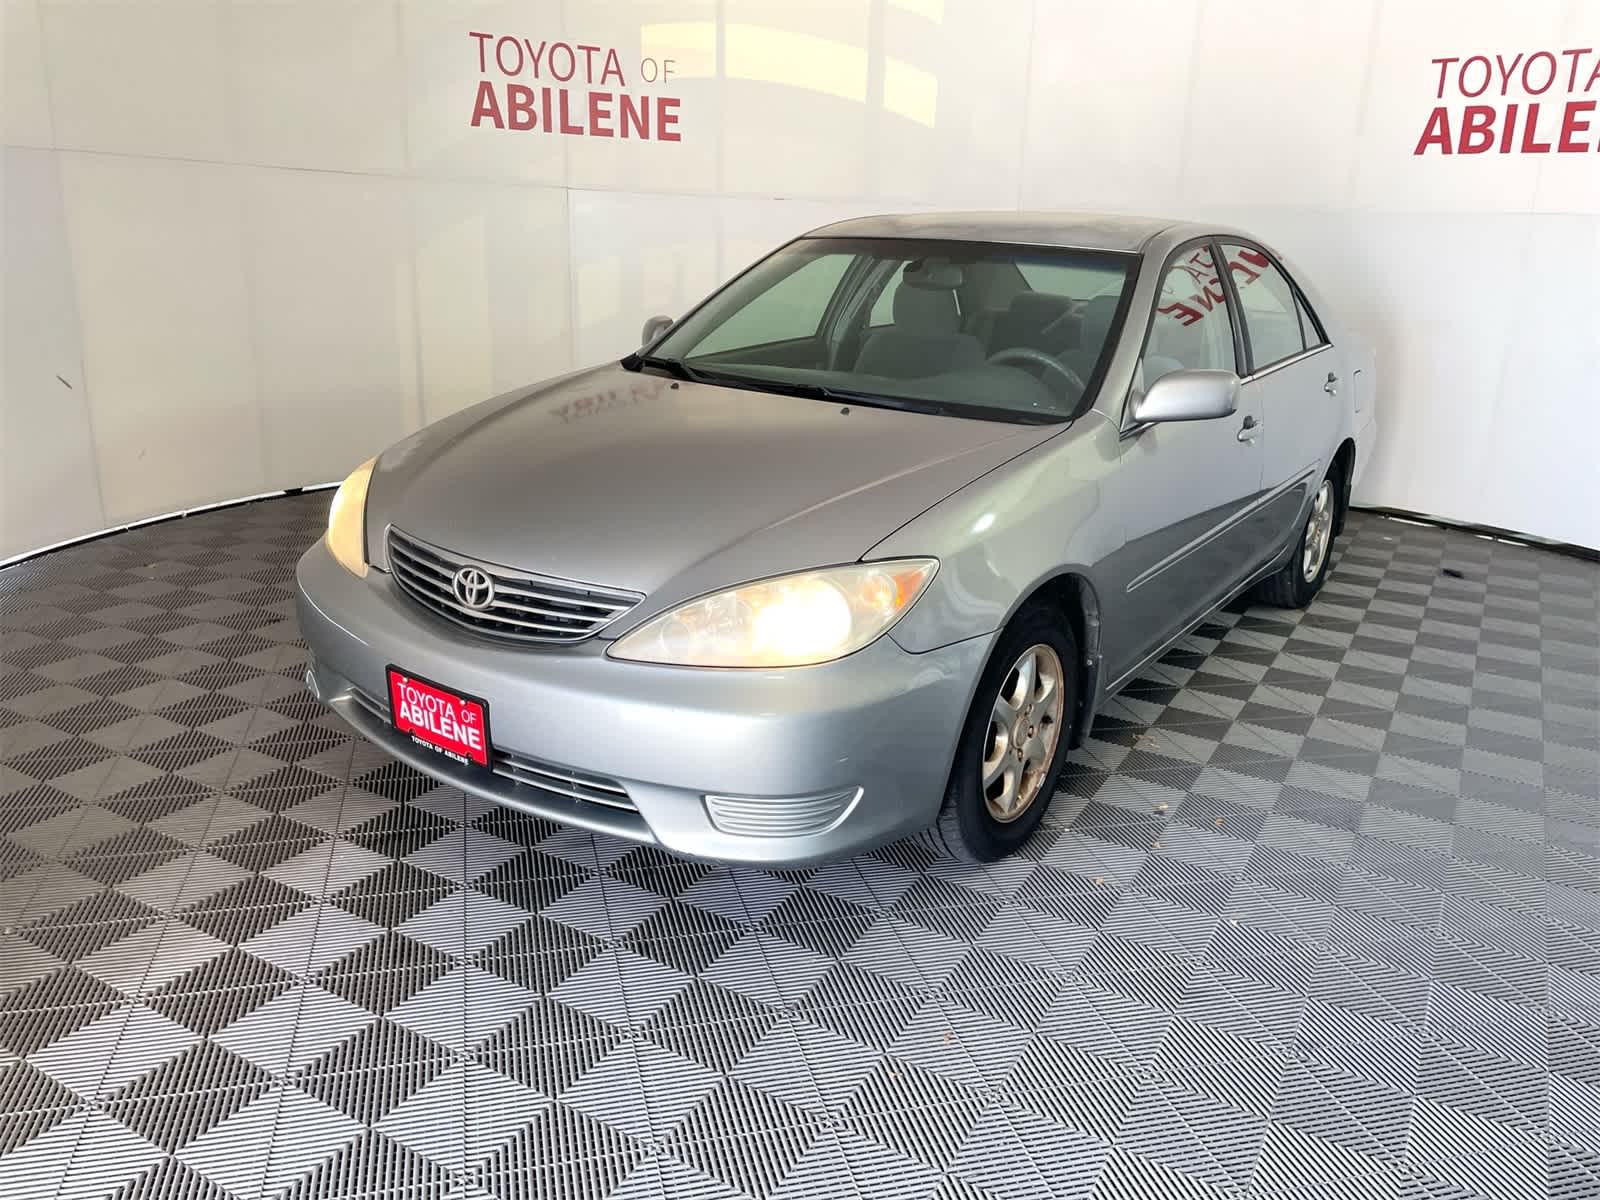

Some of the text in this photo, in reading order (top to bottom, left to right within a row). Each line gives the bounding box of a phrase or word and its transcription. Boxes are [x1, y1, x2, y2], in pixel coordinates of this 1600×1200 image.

[469, 31, 676, 87] TOYOTA OF
[471, 81, 681, 141] ABILENE
[1413, 100, 1600, 155] ABILE
[397, 682, 476, 723] TOYOTA OF
[400, 701, 482, 750] ABILENE
[411, 736, 433, 749] TOYOTA
